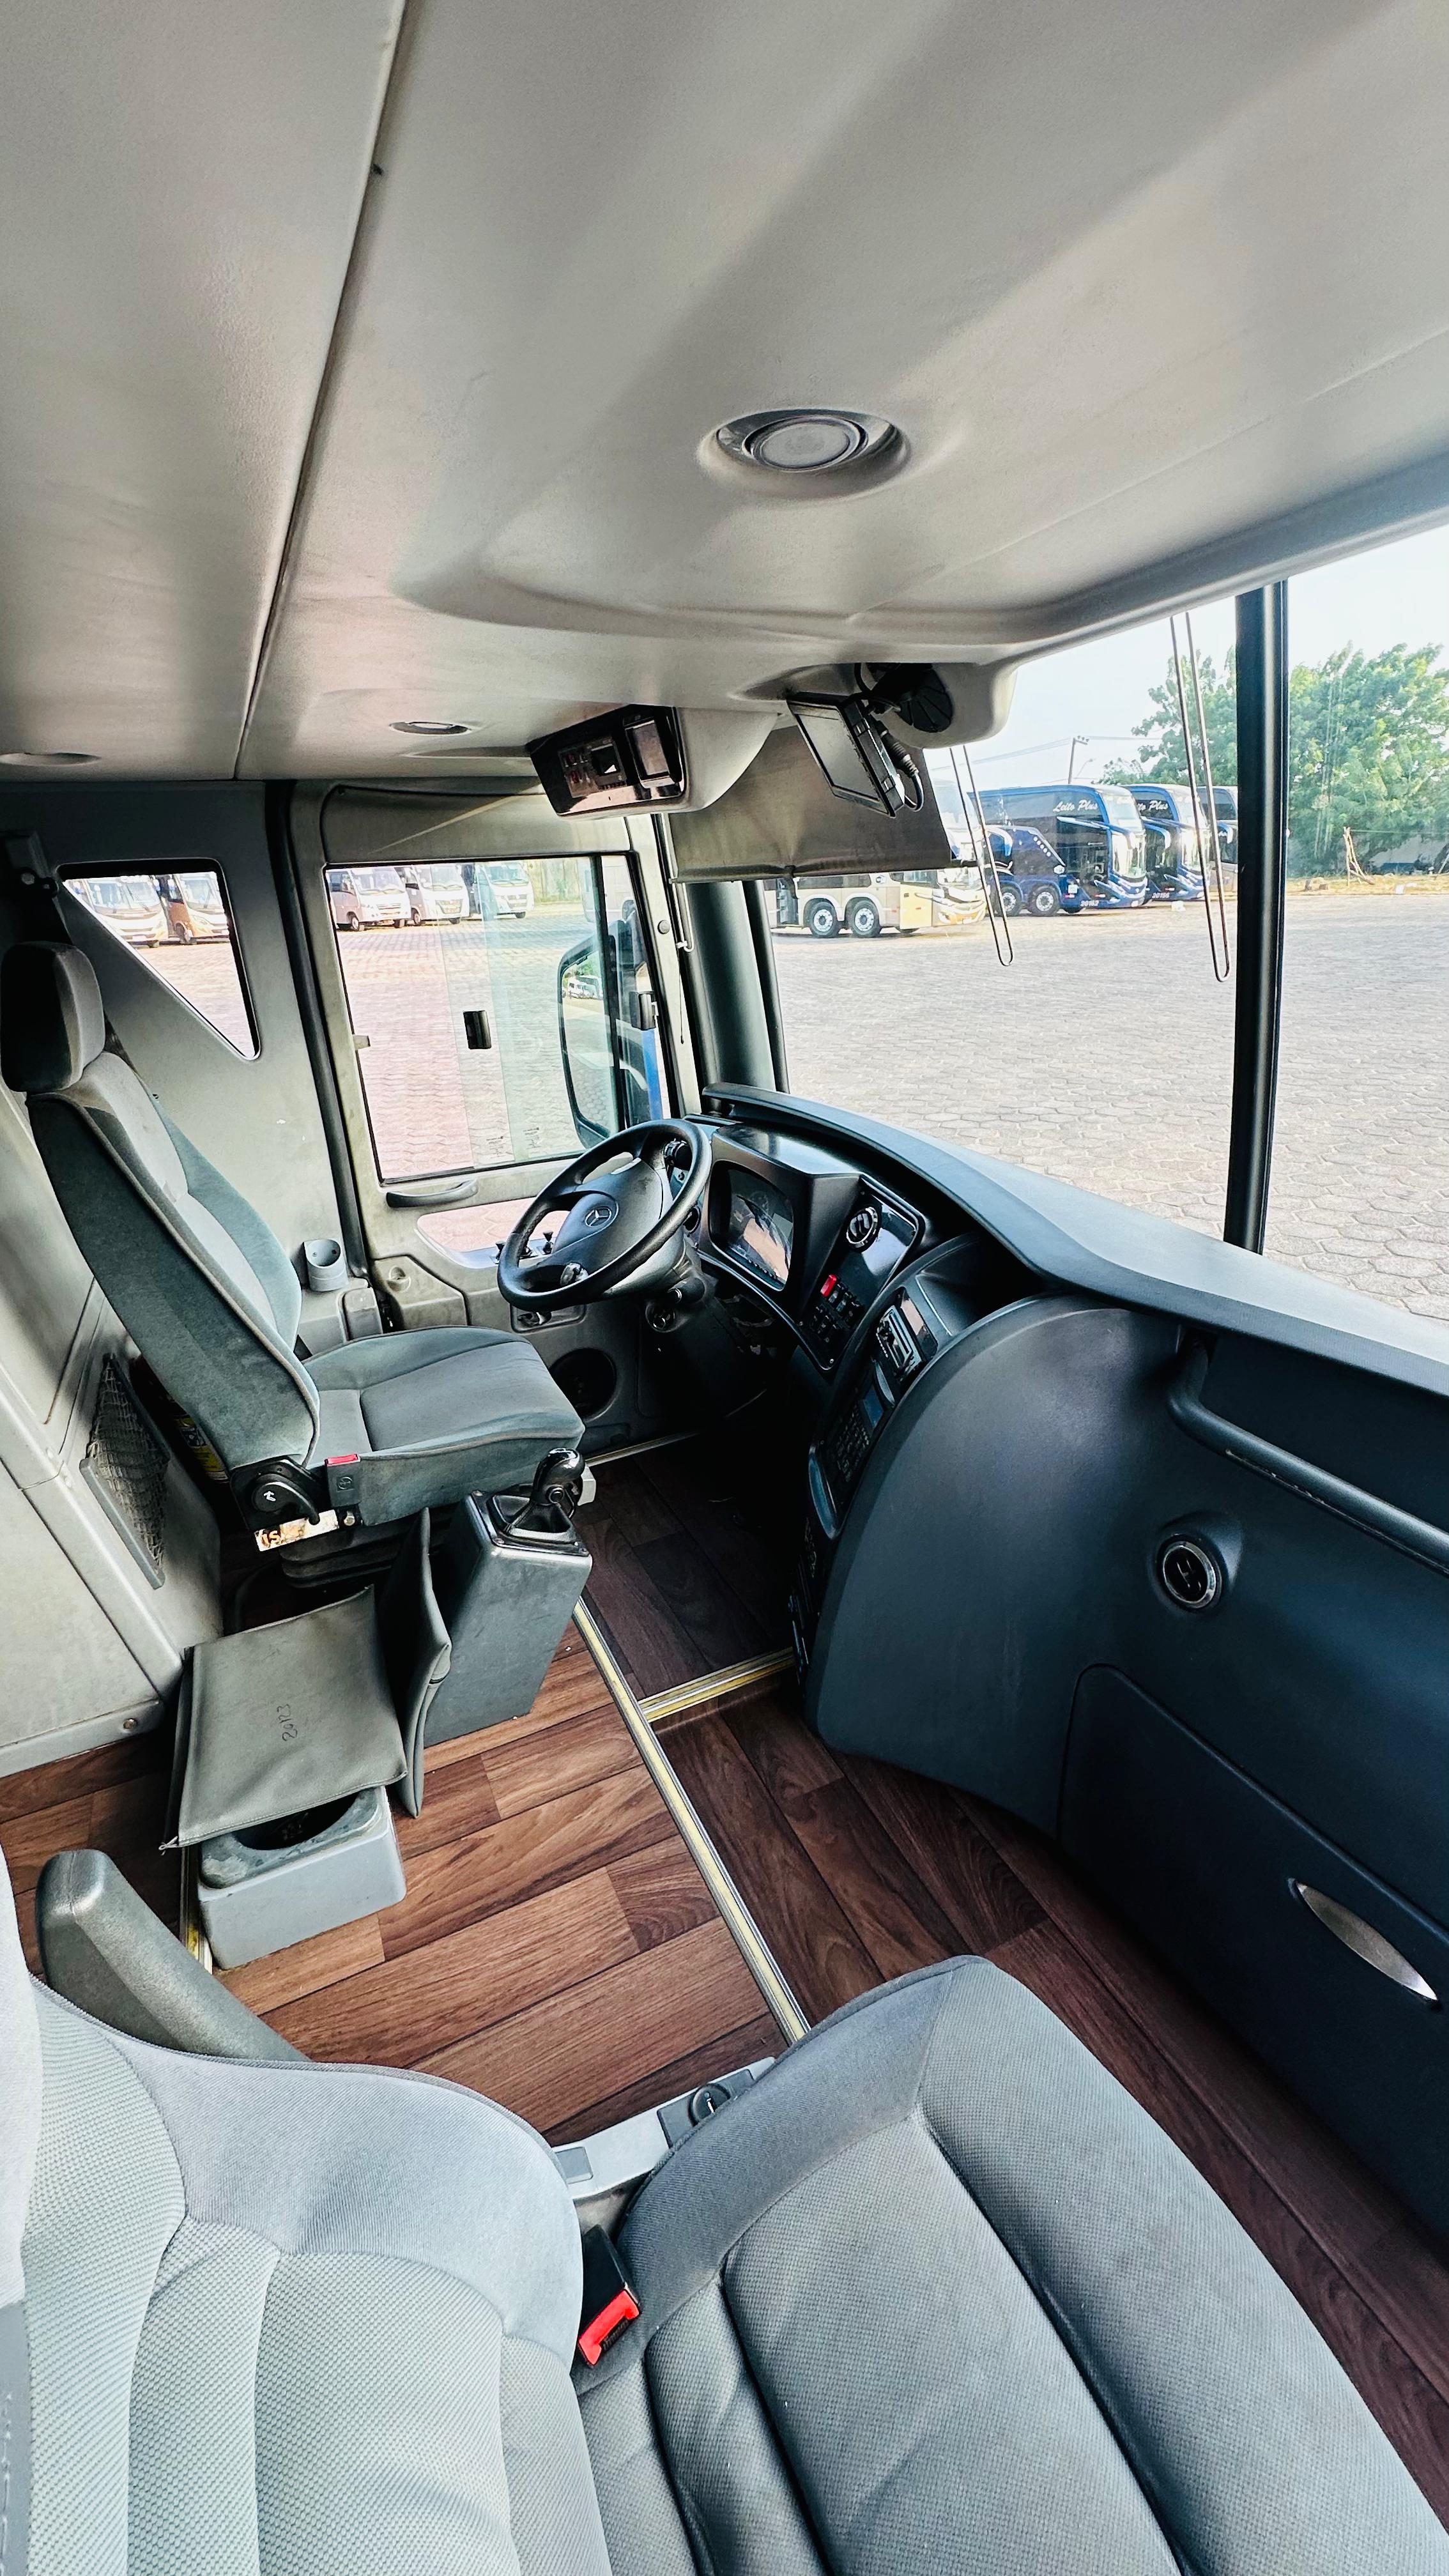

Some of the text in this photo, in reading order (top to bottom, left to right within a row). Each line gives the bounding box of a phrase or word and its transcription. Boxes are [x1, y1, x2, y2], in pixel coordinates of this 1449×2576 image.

[1053, 799, 1098, 812] Leito Plus
[1148, 800, 1169, 811] Plus
